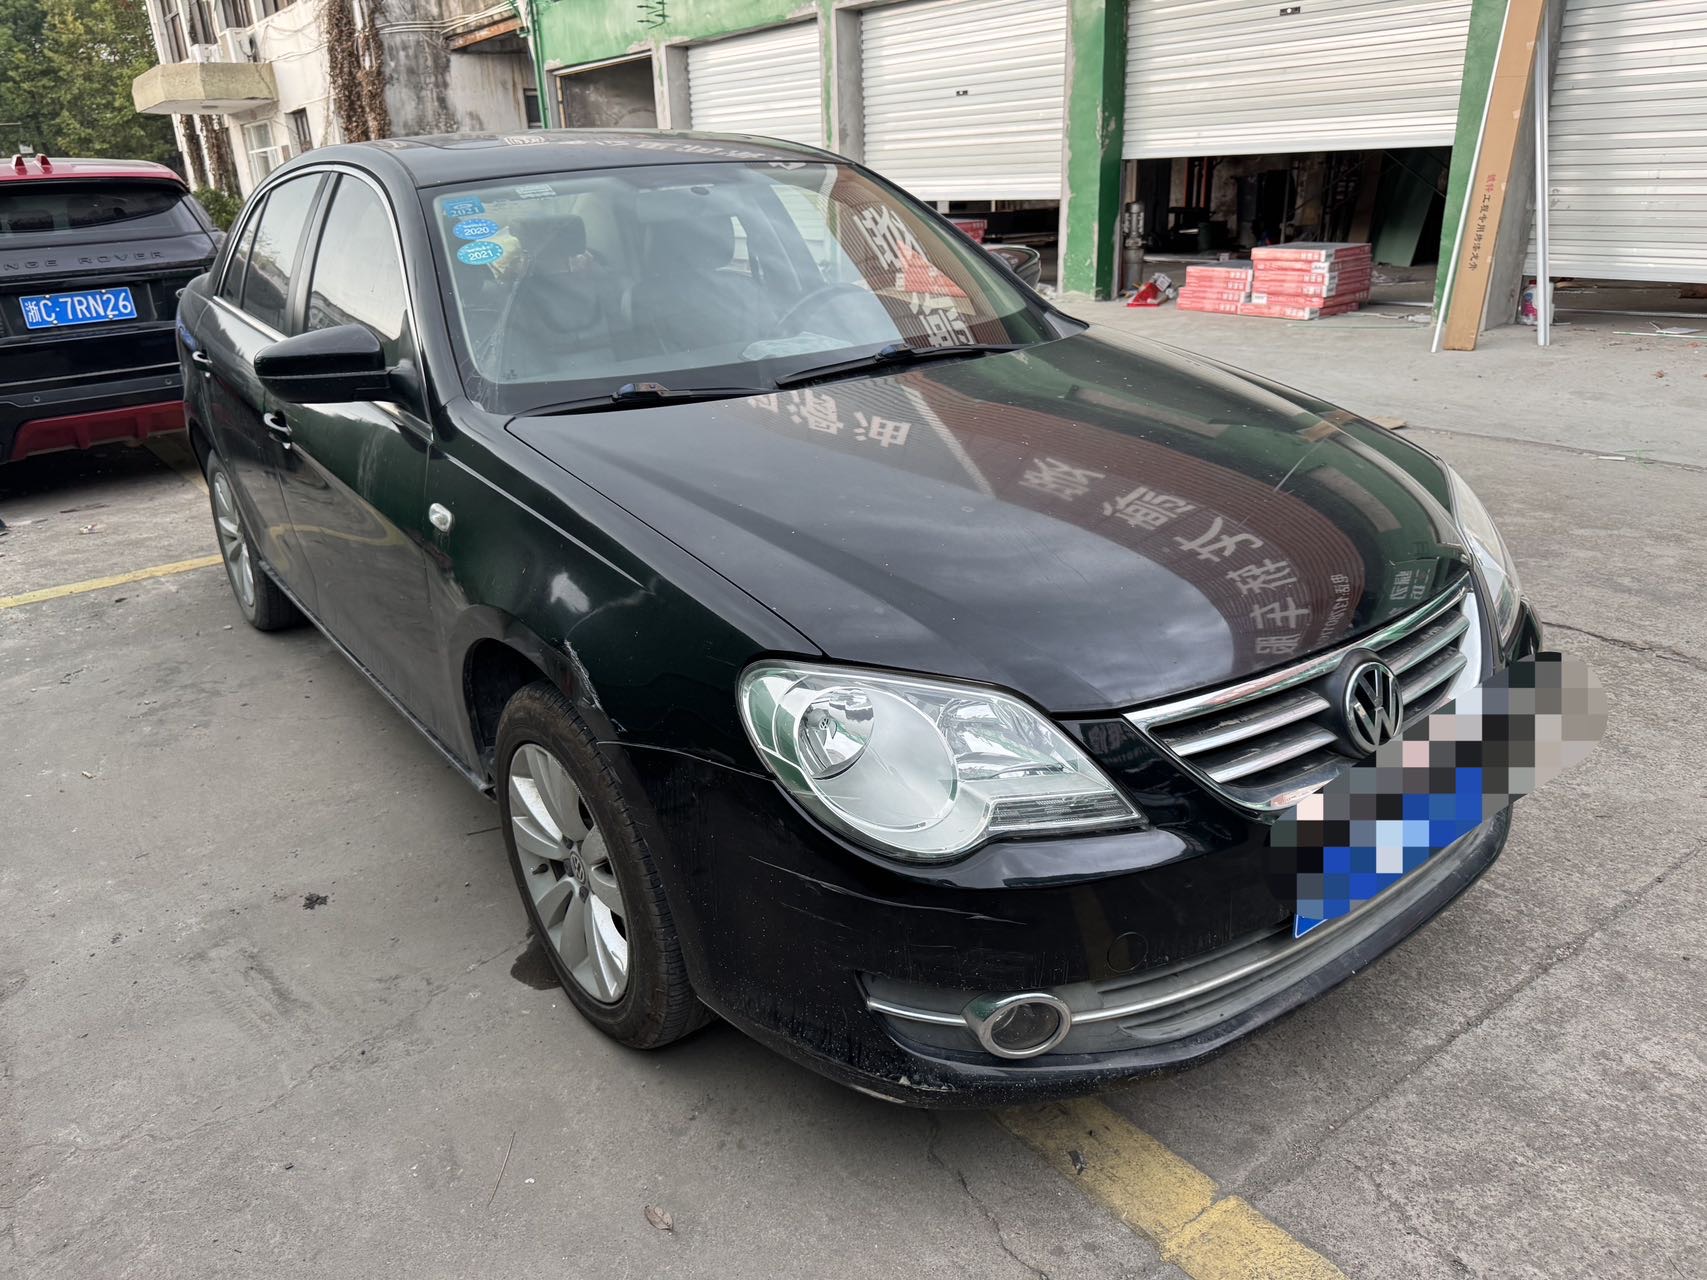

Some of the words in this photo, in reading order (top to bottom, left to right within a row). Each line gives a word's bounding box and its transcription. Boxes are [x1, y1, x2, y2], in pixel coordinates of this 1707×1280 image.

[464, 226, 490, 236] 2020
[79, 251, 164, 265] ROVER
[468, 249, 494, 260] 2021
